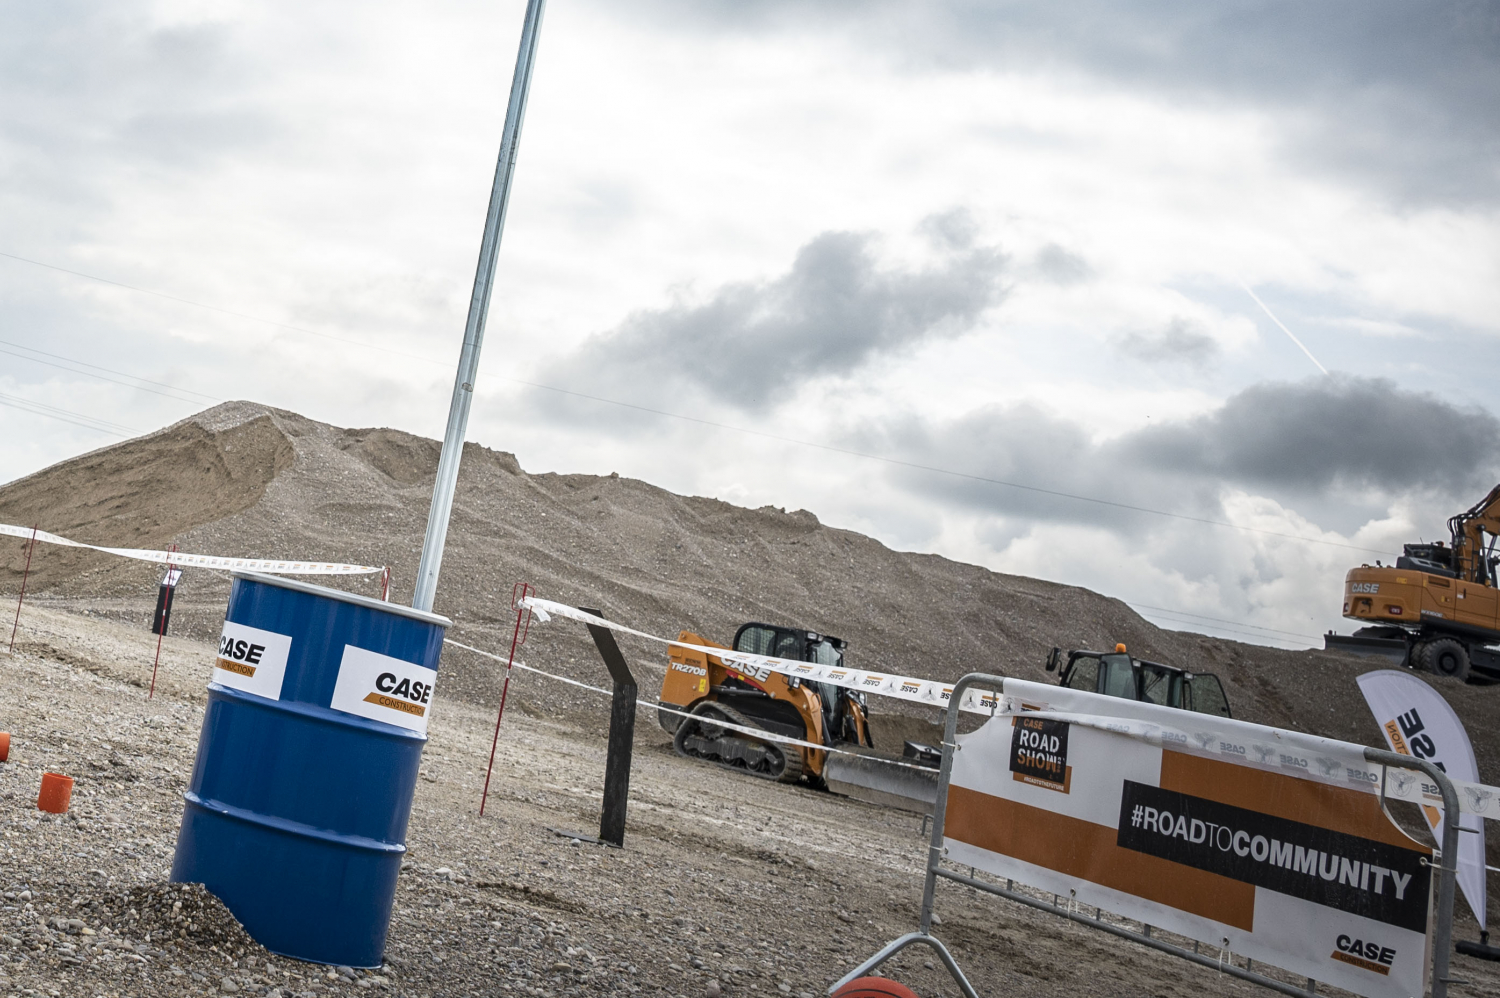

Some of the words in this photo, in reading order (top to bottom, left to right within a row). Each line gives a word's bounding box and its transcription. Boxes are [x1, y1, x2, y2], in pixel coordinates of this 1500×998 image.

[1352, 583, 1379, 594] CASE
[219, 635, 266, 665] CASE
[219, 658, 254, 675] STRUCTION
[671, 662, 707, 676] TR270B
[376, 672, 432, 705] CASE
[940, 692, 951, 700] SE
[1024, 718, 1043, 730] CASE
[1020, 729, 1060, 753] ROAD
[1017, 748, 1057, 773] SHOW
[1131, 804, 1412, 900] #ROADTOCOMMUNITY
[1336, 934, 1396, 966] CASE
